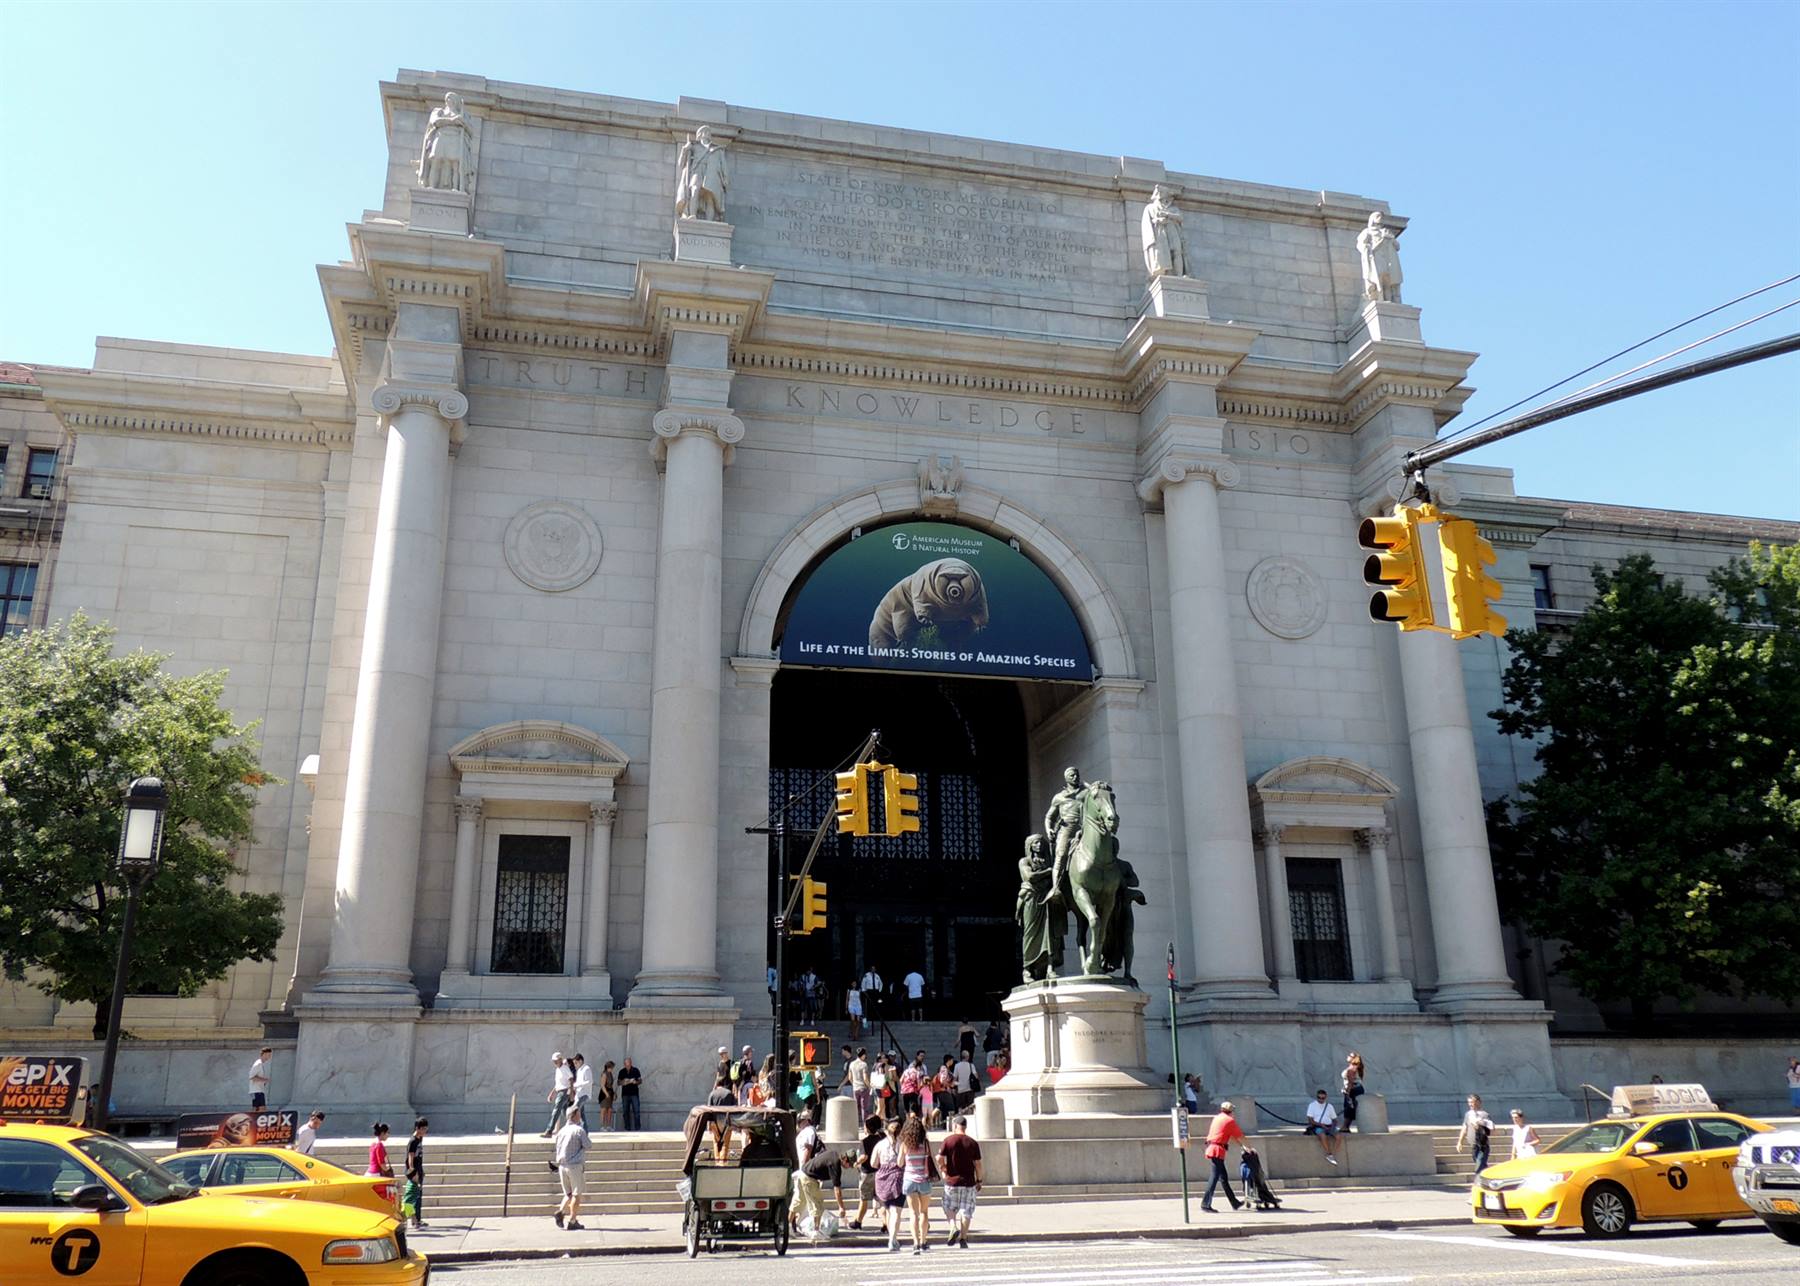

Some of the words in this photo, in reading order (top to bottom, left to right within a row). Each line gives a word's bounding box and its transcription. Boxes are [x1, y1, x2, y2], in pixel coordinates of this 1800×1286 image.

[799, 173, 842, 187] STATE
[848, 178, 868, 190] OF
[873, 182, 905, 195] NEW
[913, 186, 952, 201] YORK
[959, 192, 1033, 212] MEMORIAL
[1040, 202, 1057, 215] TO
[830, 188, 925, 211] THEODORE
[932, 201, 1027, 224] ROOSEVELT
[750, 205, 762, 216] IN
[768, 207, 815, 221] ENERGY
[819, 214, 846, 225] AND
[943, 228, 963, 240] THE
[1025, 238, 1051, 250] OUR
[789, 221, 802, 232] IN
[870, 230, 887, 242] OF
[891, 233, 915, 243] THE
[919, 214, 943, 225] THE
[777, 231, 791, 241] IN
[869, 242, 896, 254] AND
[802, 247, 831, 258] AND
[835, 250, 852, 261] OF
[1029, 273, 1056, 283] MAN
[479, 356, 648, 394] TRUTH
[786, 385, 1086, 434] KNOWLEDGE
[1228, 428, 1312, 455] ISIO
[912, 535, 949, 545] AMERICAN
[950, 537, 983, 547] MUSEUM
[918, 543, 950, 553] NATURAL
[951, 546, 980, 555] HISTORY
[799, 641, 823, 653] LIFE
[826, 645, 840, 654] AT
[842, 645, 864, 656] THE
[867, 645, 909, 658] LIMITS:
[911, 647, 956, 661] STORIES
[959, 652, 974, 662] OF
[976, 651, 1031, 665] AMAZING
[1033, 654, 1076, 668] SPECIES
[2, 1095, 67, 1108] MOVIES
[6, 1085, 23, 1094] WE
[25, 1085, 48, 1094] GET
[49, 1086, 69, 1095] BIG
[256, 1131, 291, 1141] MOVIES
[30, 1236, 53, 1245] NYC
[64, 1237, 92, 1271] T
